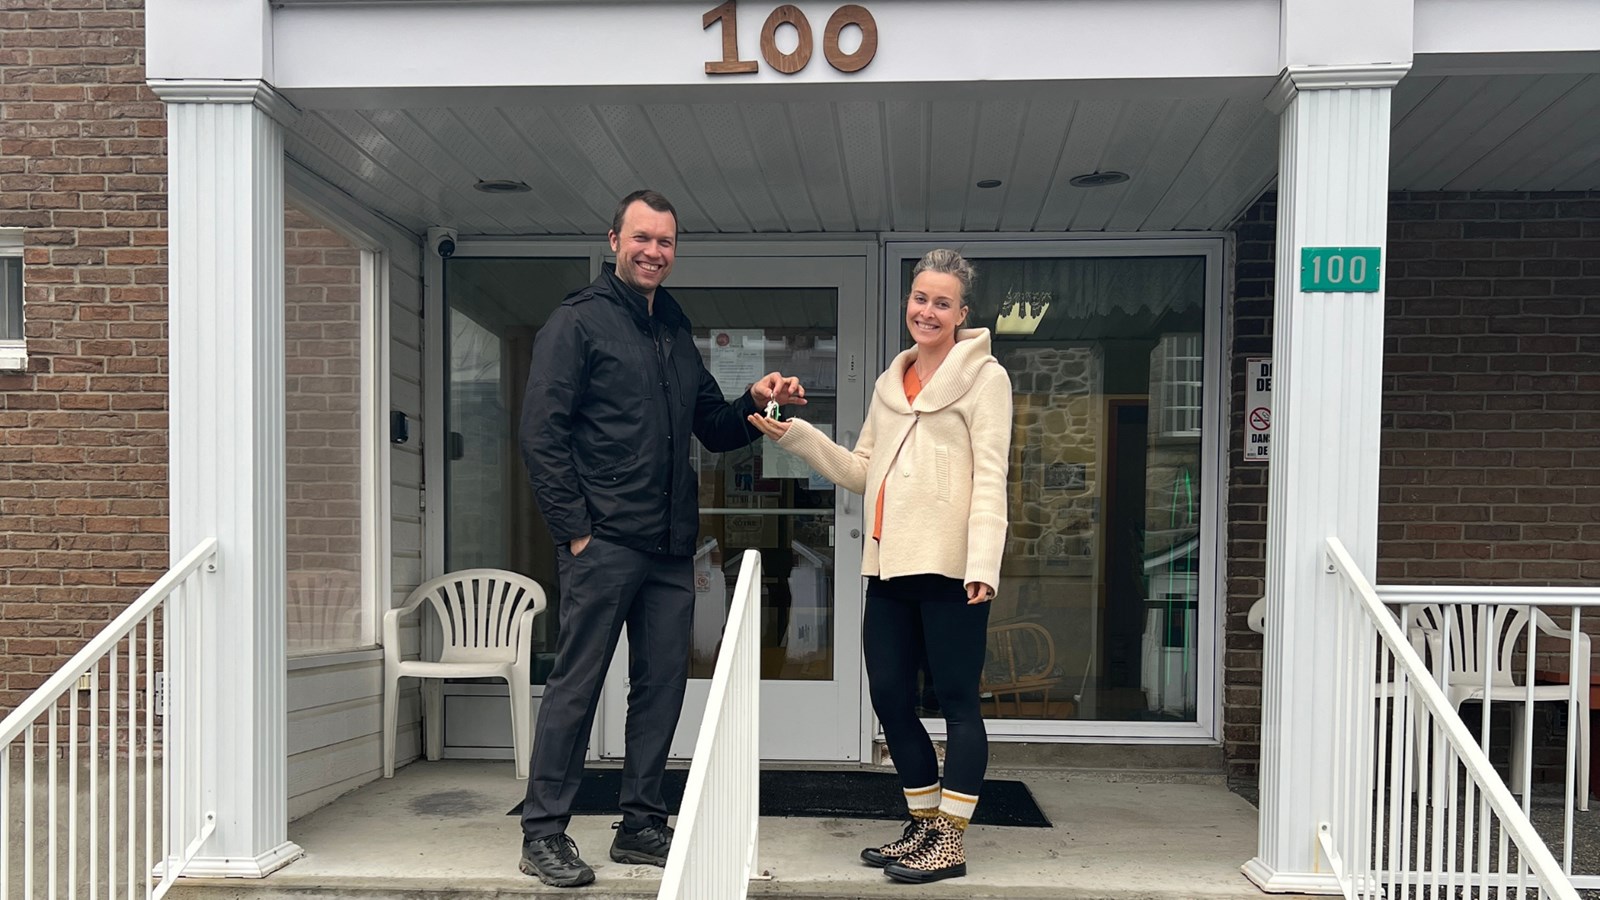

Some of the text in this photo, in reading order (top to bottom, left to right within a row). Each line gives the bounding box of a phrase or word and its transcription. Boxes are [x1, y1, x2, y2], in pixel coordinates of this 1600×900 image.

[702, 0, 878, 74] 100
[1312, 255, 1367, 284] 100
[1256, 378, 1271, 391] DE
[1257, 446, 1268, 455] DE
